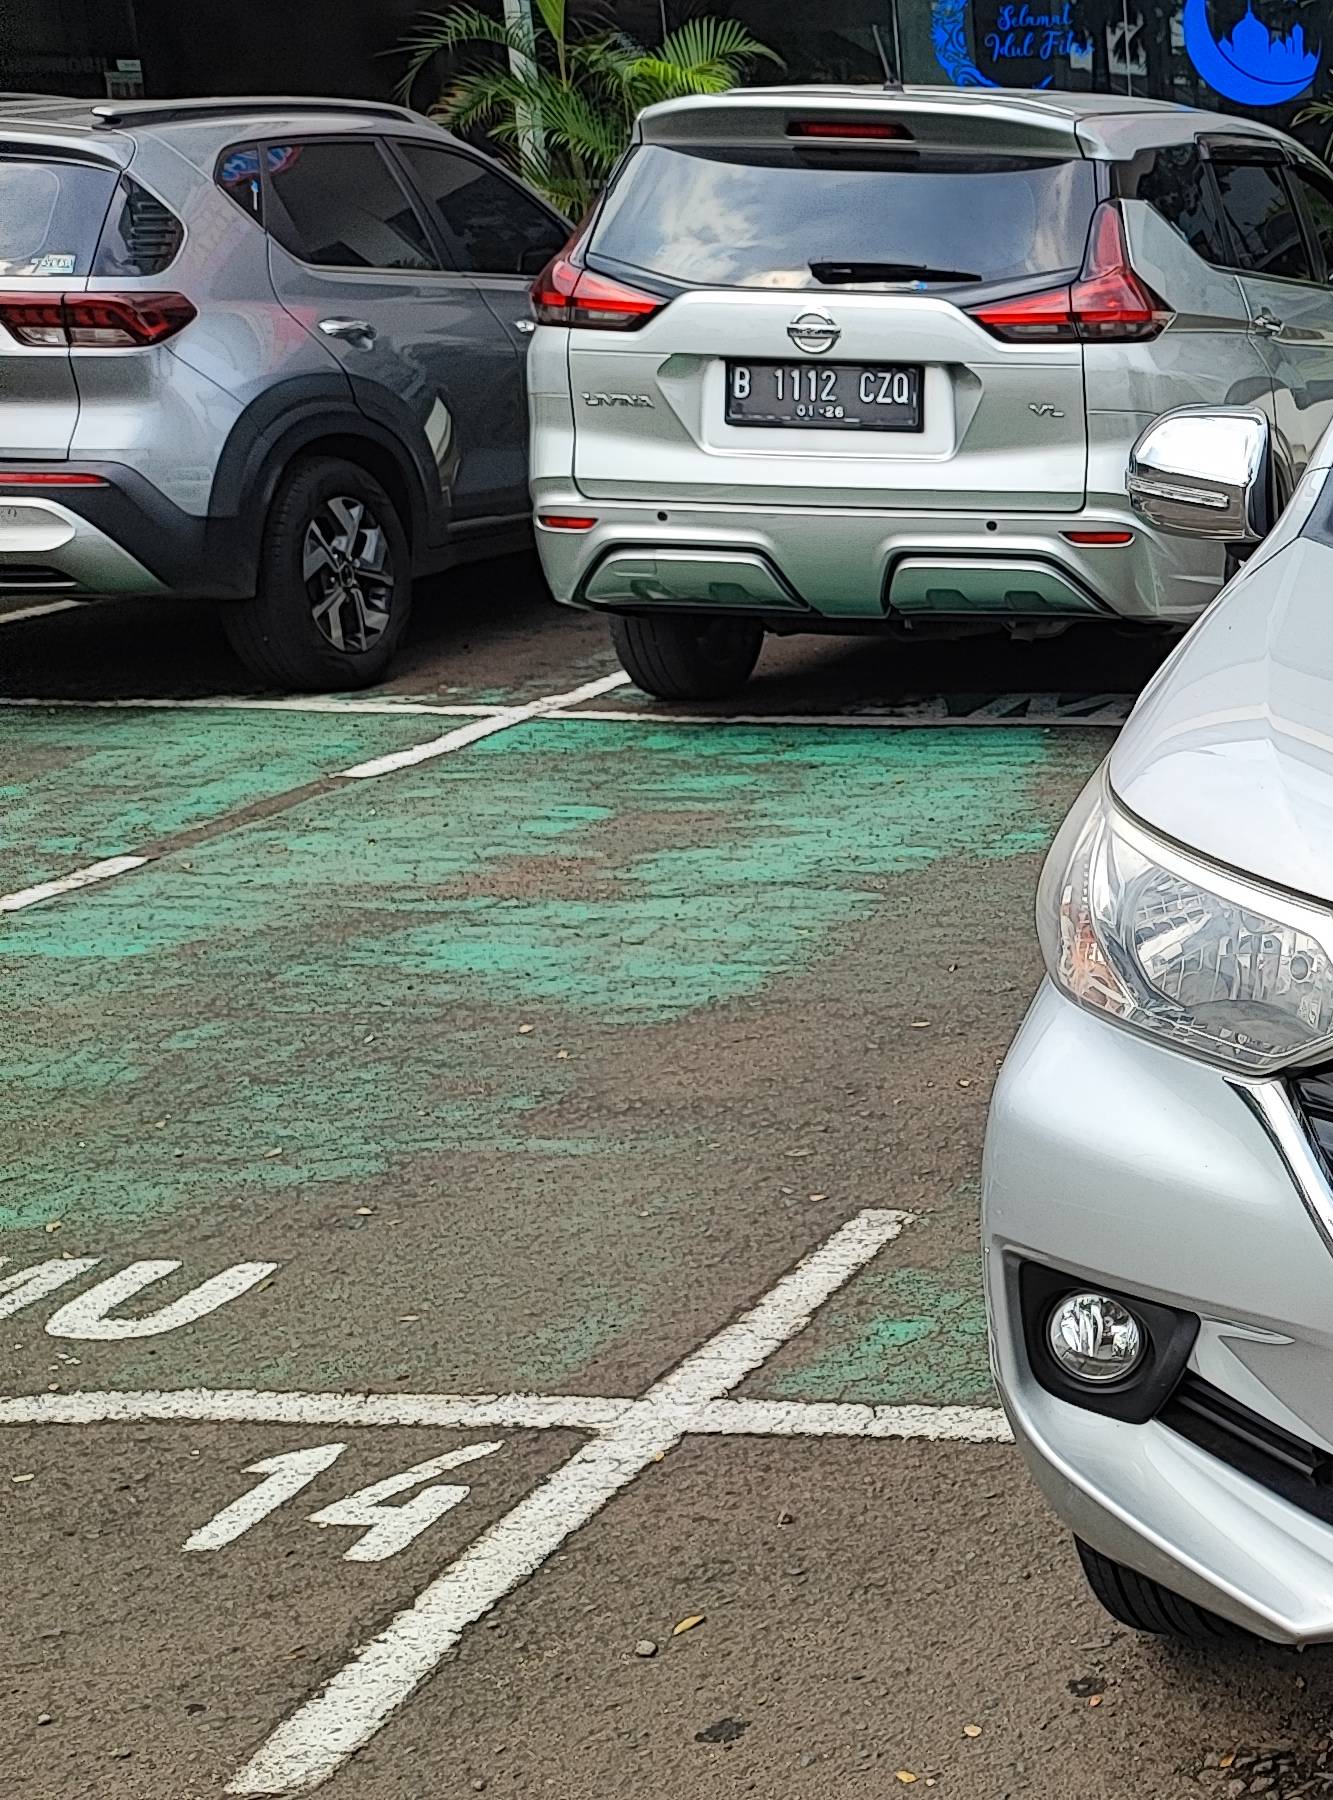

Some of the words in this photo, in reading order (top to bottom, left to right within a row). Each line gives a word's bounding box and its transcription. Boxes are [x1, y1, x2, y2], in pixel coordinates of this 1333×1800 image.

[997, 2, 1074, 31] Selamat
[984, 31, 1034, 62] Idul
[733, 366, 751, 399] B
[774, 368, 837, 401] 1112
[859, 371, 909, 404] CZQ
[181, 1439, 506, 1562] 14
